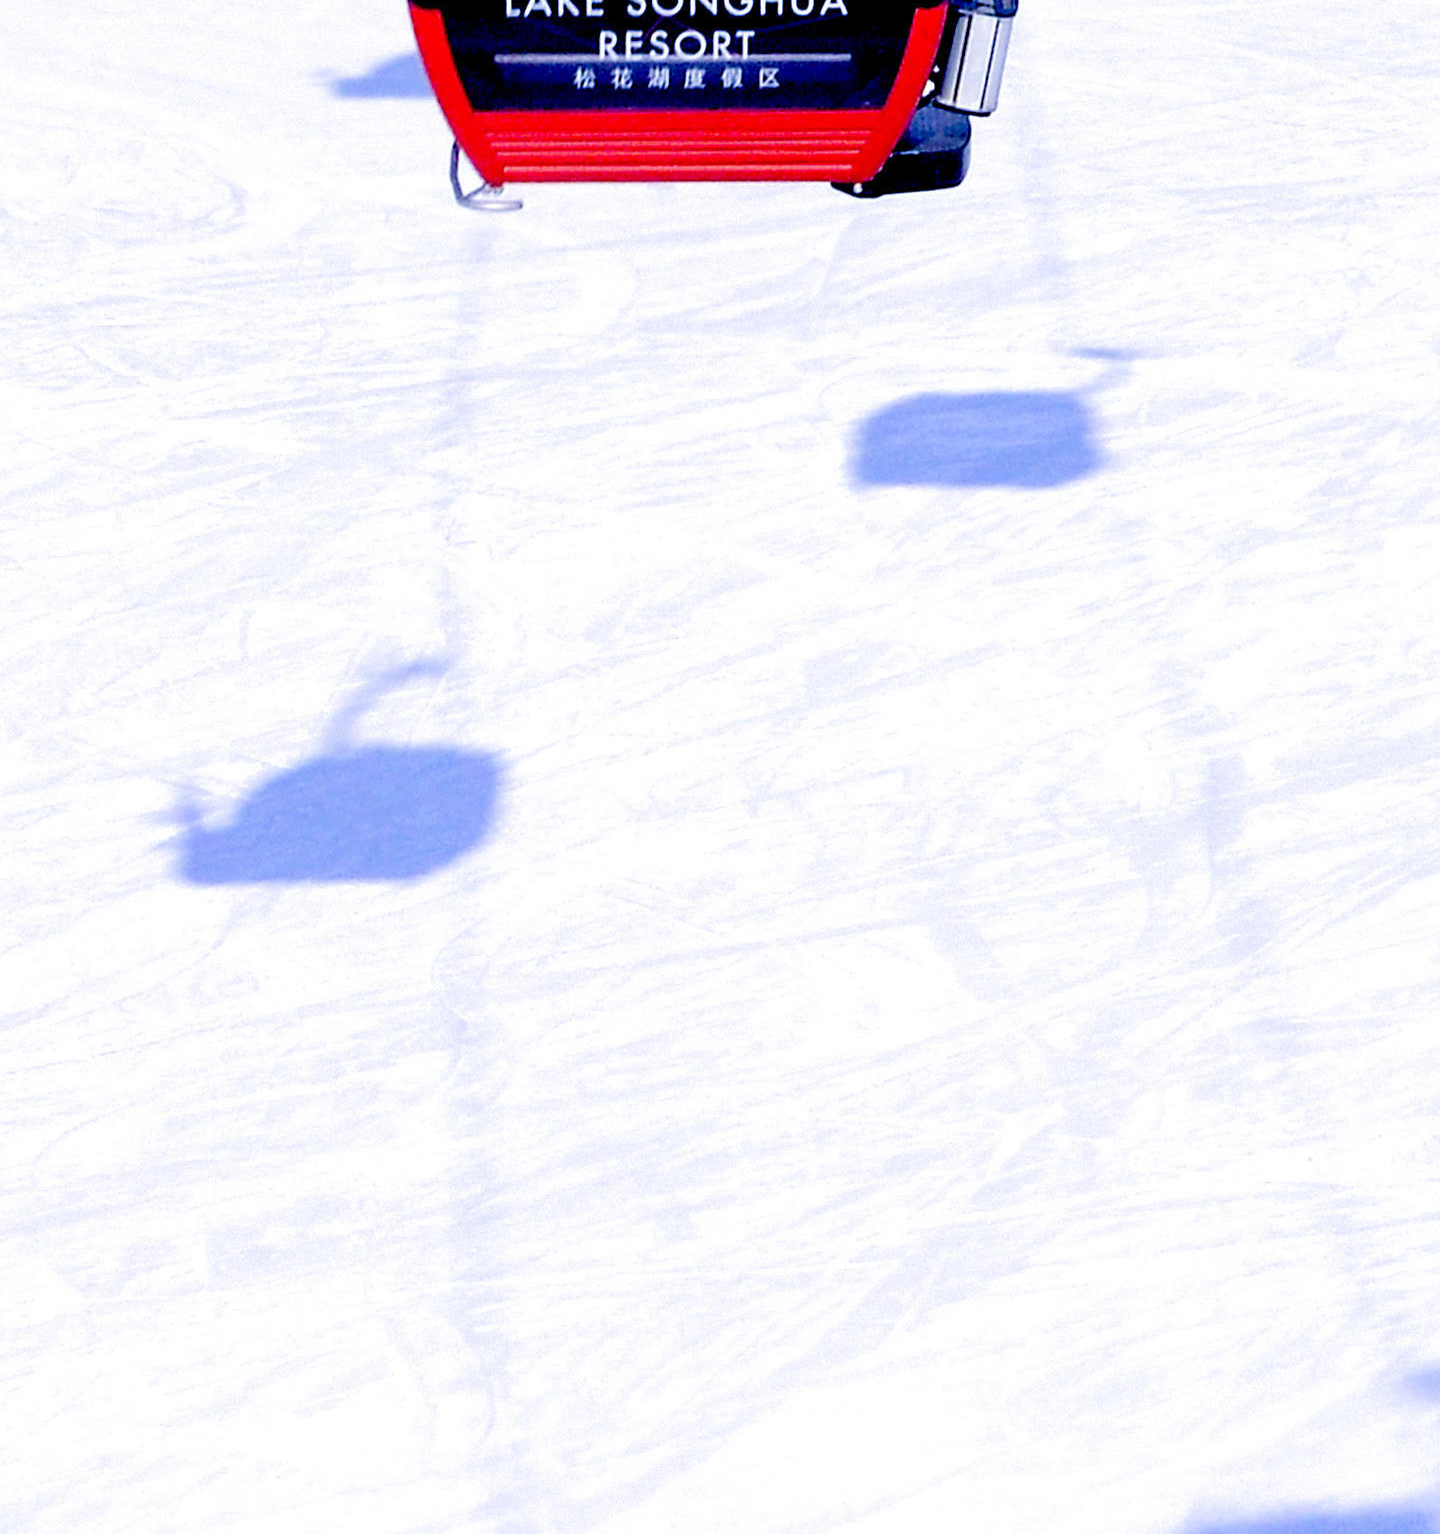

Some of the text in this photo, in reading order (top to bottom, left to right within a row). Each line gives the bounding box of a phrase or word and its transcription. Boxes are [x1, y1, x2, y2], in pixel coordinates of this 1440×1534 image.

[599, 30, 755, 61] RESORT
[573, 66, 780, 90] 松花湖度假区
